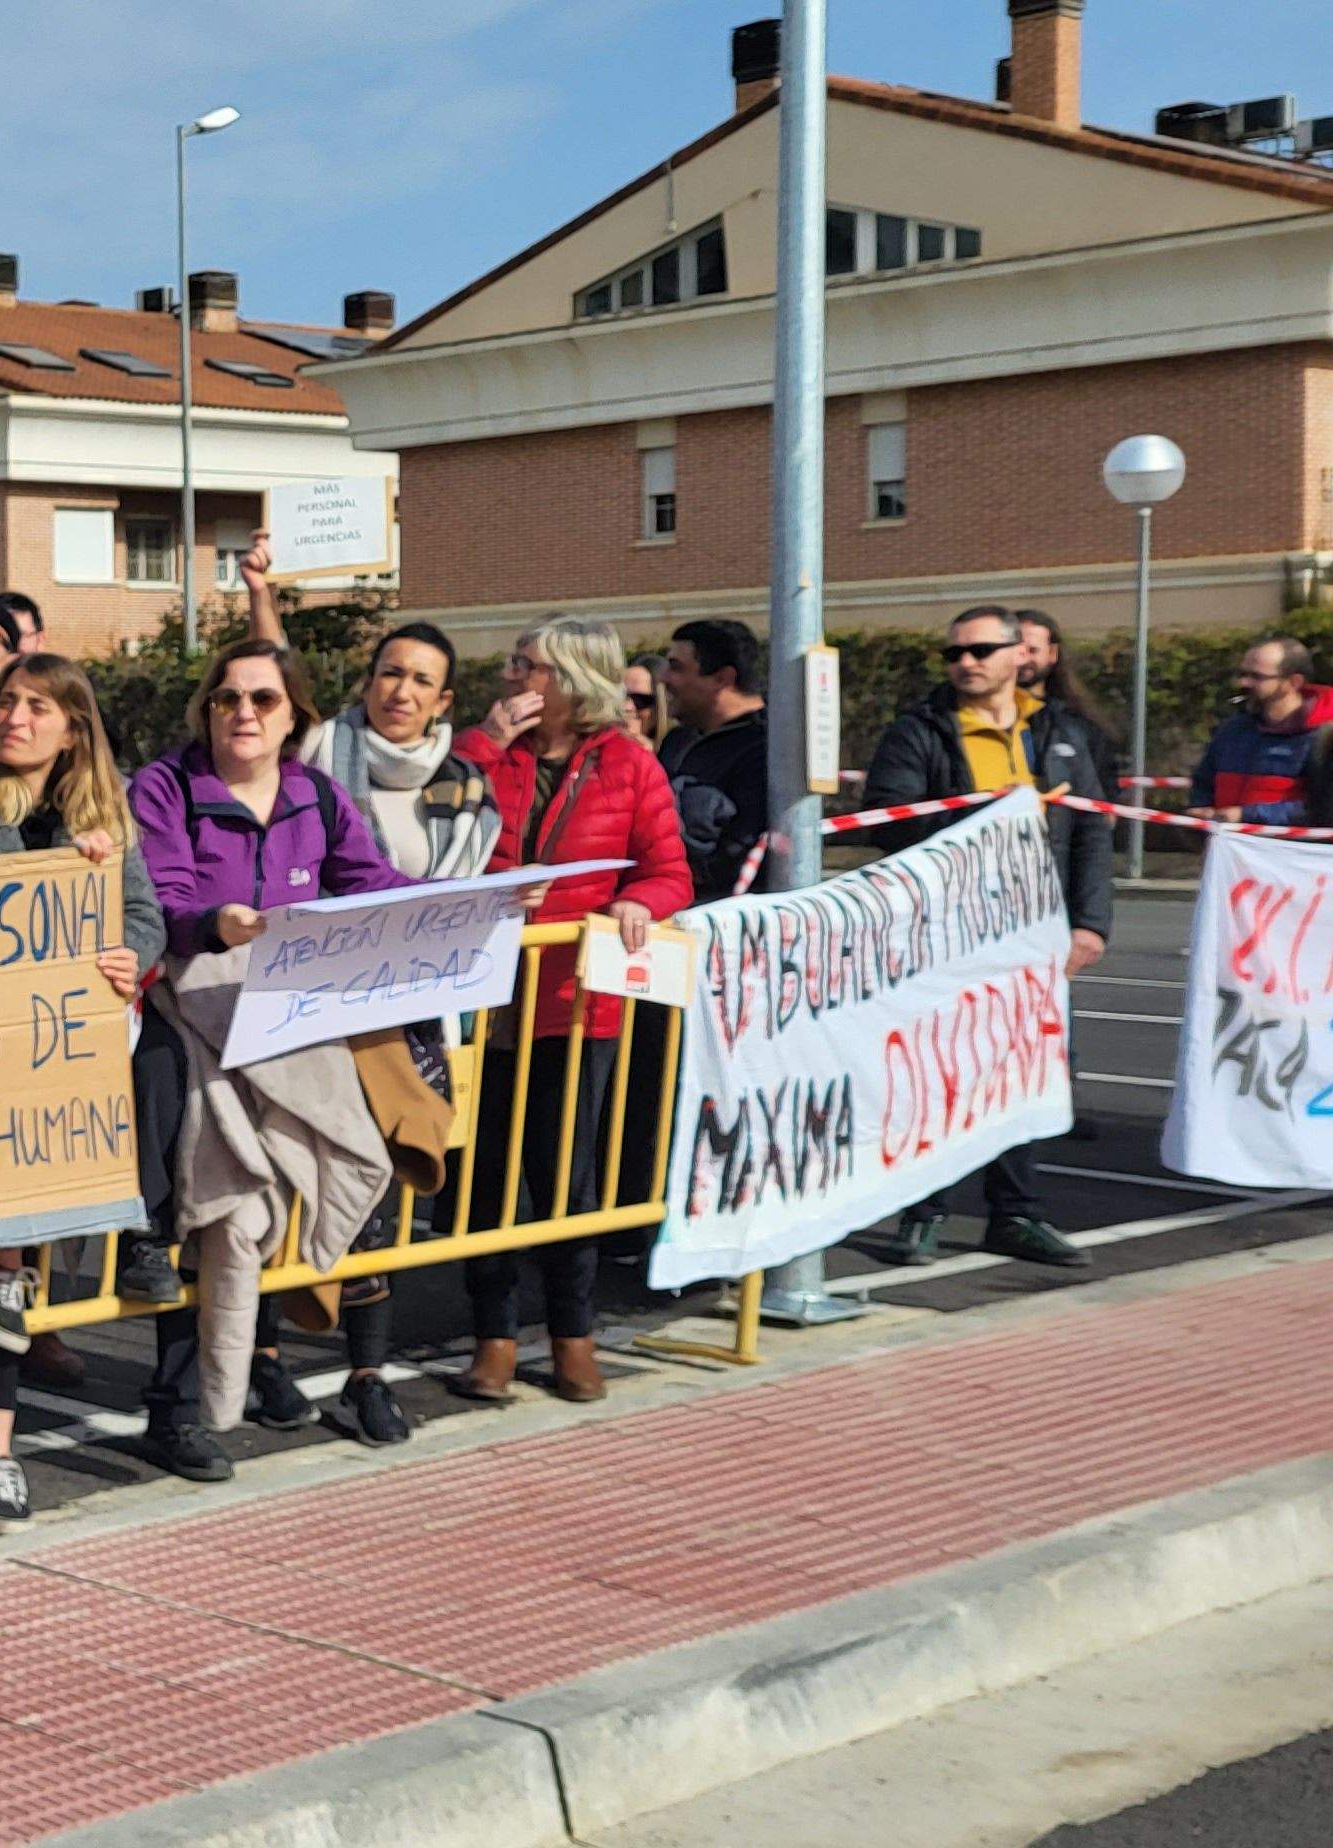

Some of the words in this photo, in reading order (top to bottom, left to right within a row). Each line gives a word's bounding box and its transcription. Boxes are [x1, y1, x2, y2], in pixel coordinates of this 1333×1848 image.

[297, 498, 358, 513] PERSONAL
[311, 514, 344, 527] PARA
[294, 529, 363, 547] URGENCIAS
[31, 986, 97, 1070] DE
